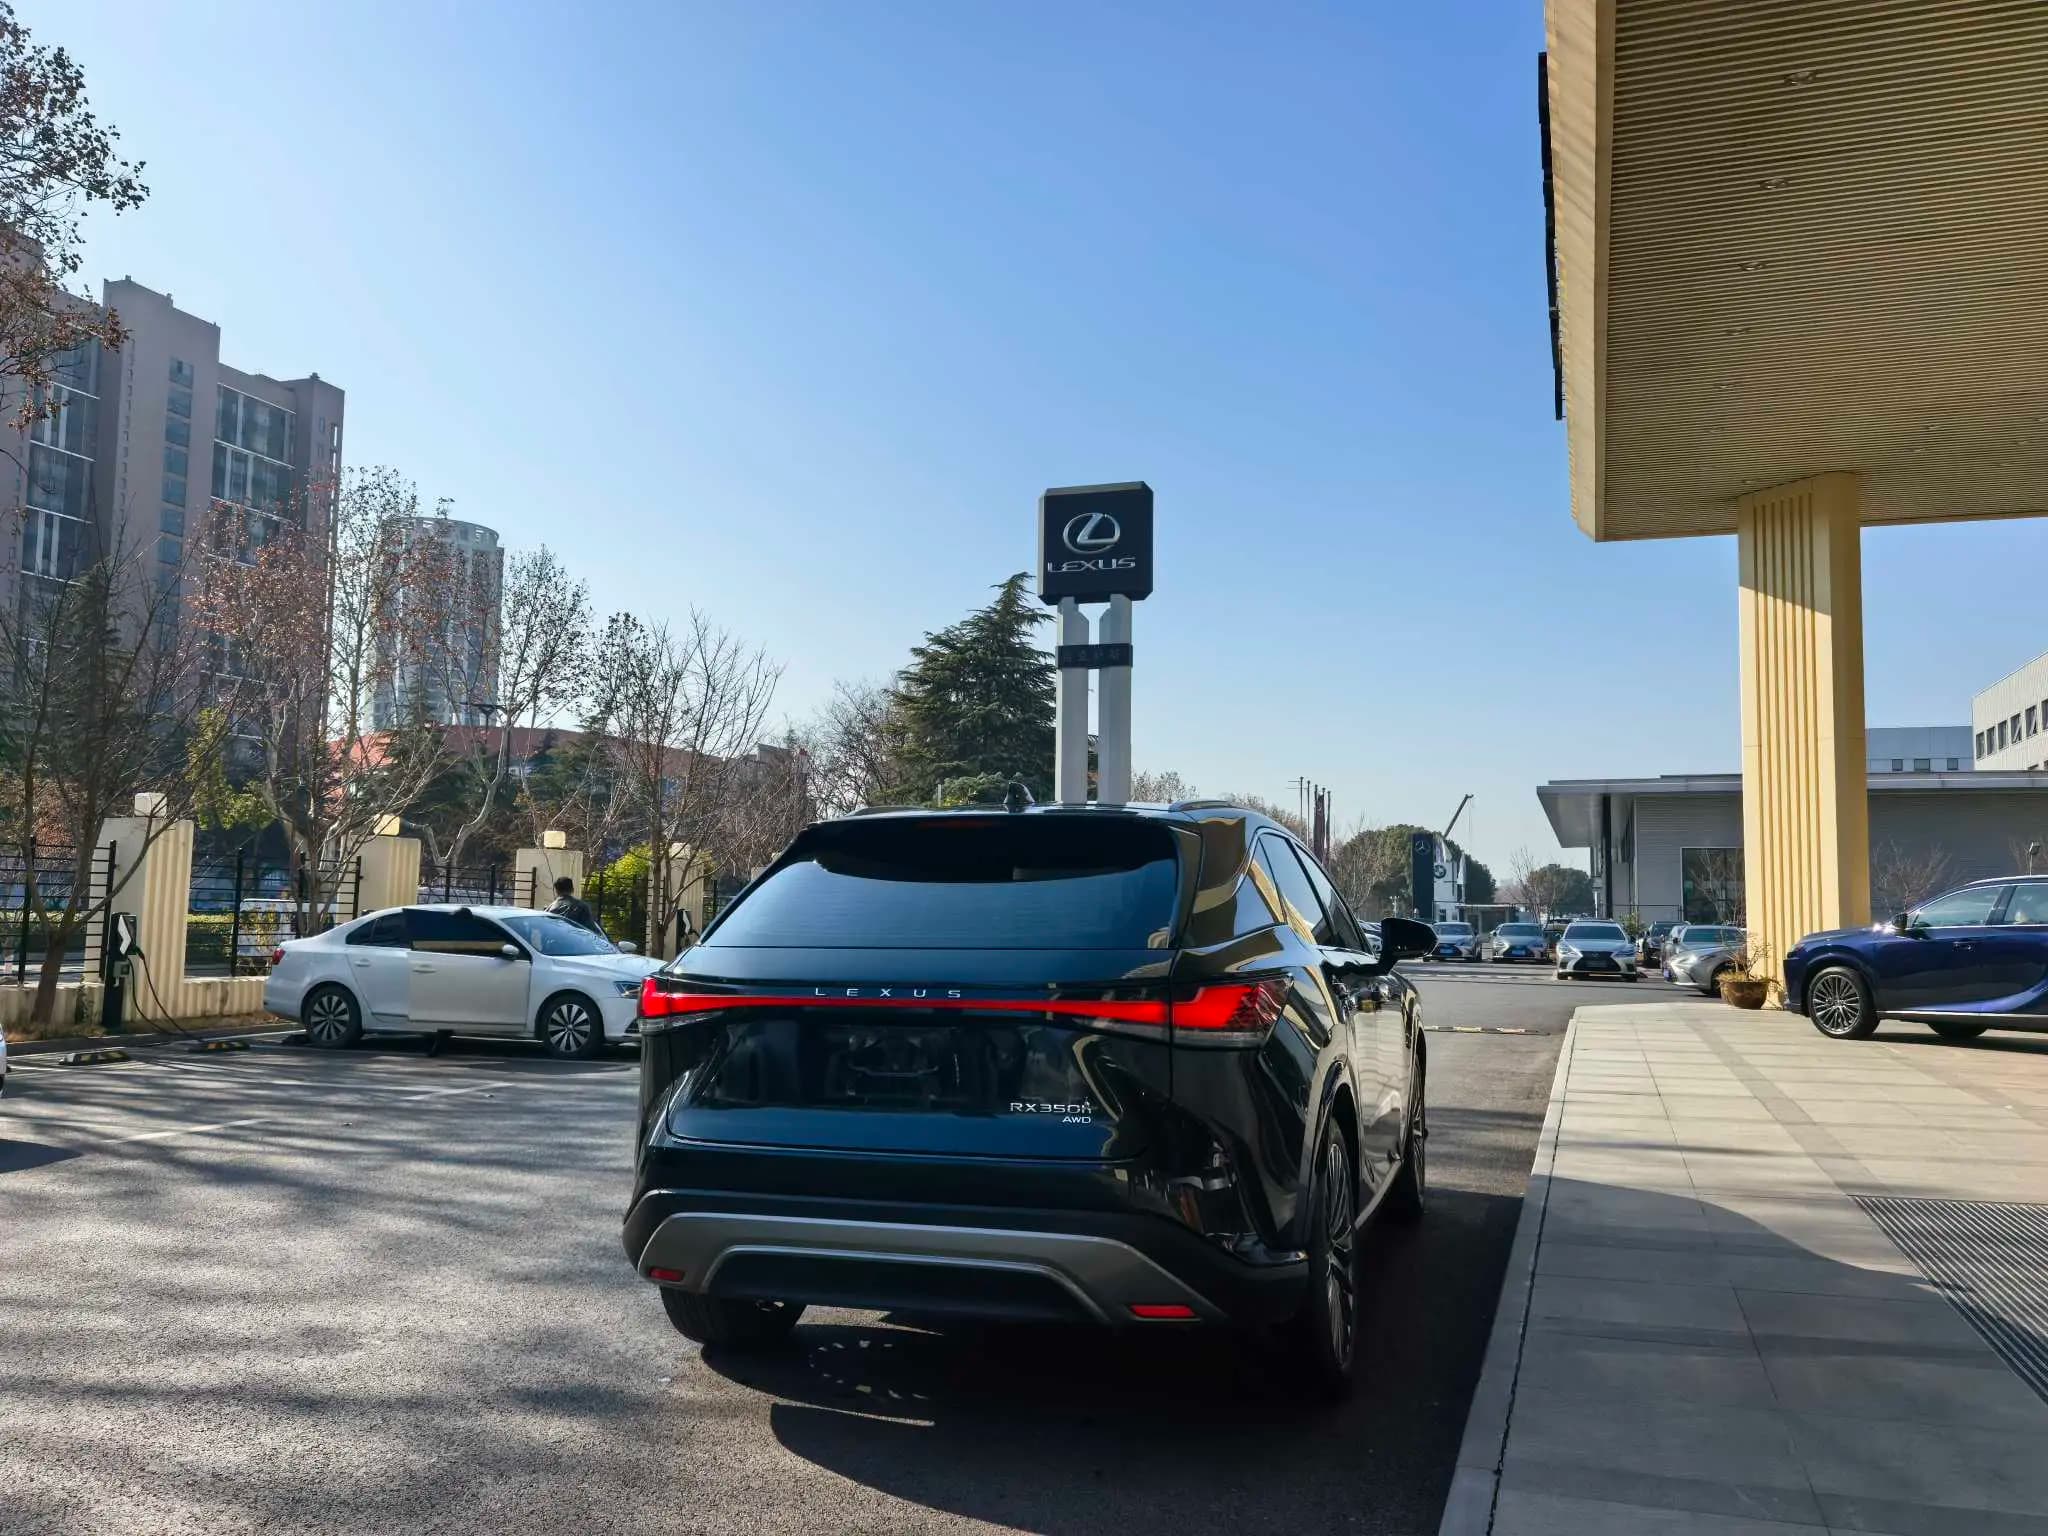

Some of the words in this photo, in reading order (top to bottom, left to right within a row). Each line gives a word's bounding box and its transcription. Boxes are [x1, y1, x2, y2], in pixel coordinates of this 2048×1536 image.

[1047, 557, 1136, 573] LEXUS
[815, 987, 961, 998] LEXUS
[1062, 1116, 1092, 1124] AWD
